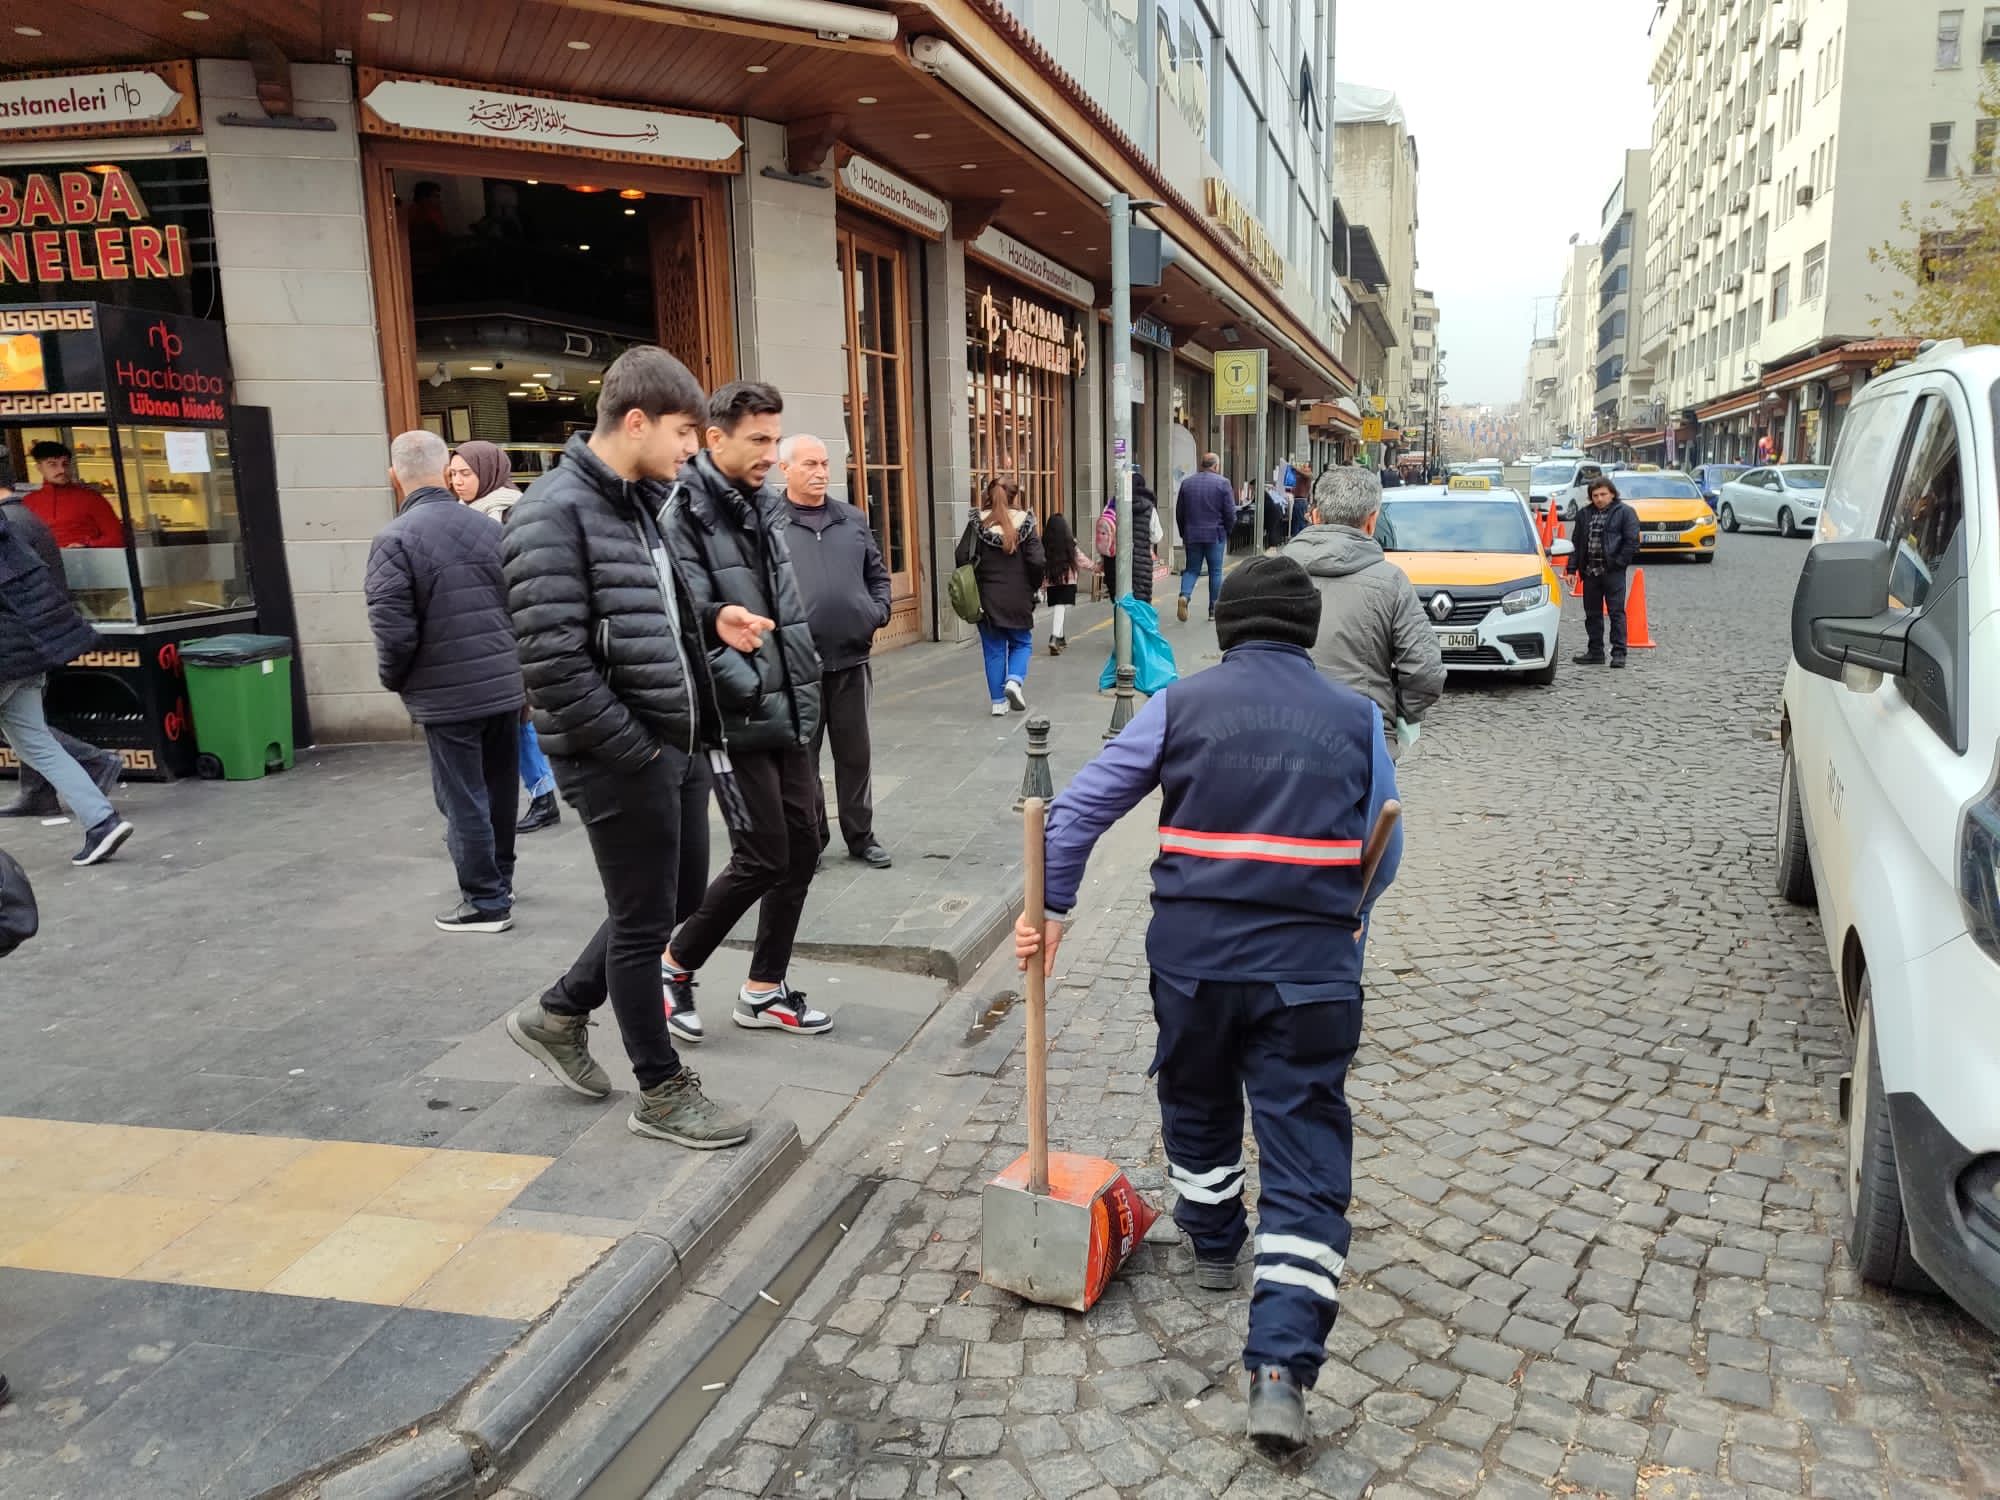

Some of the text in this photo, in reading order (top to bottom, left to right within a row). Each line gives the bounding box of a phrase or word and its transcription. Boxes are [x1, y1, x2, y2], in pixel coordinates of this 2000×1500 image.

[902, 187, 938, 224] Pastaneleri
[1231, 365, 1243, 382] T
[128, 391, 181, 418] Lübnan
